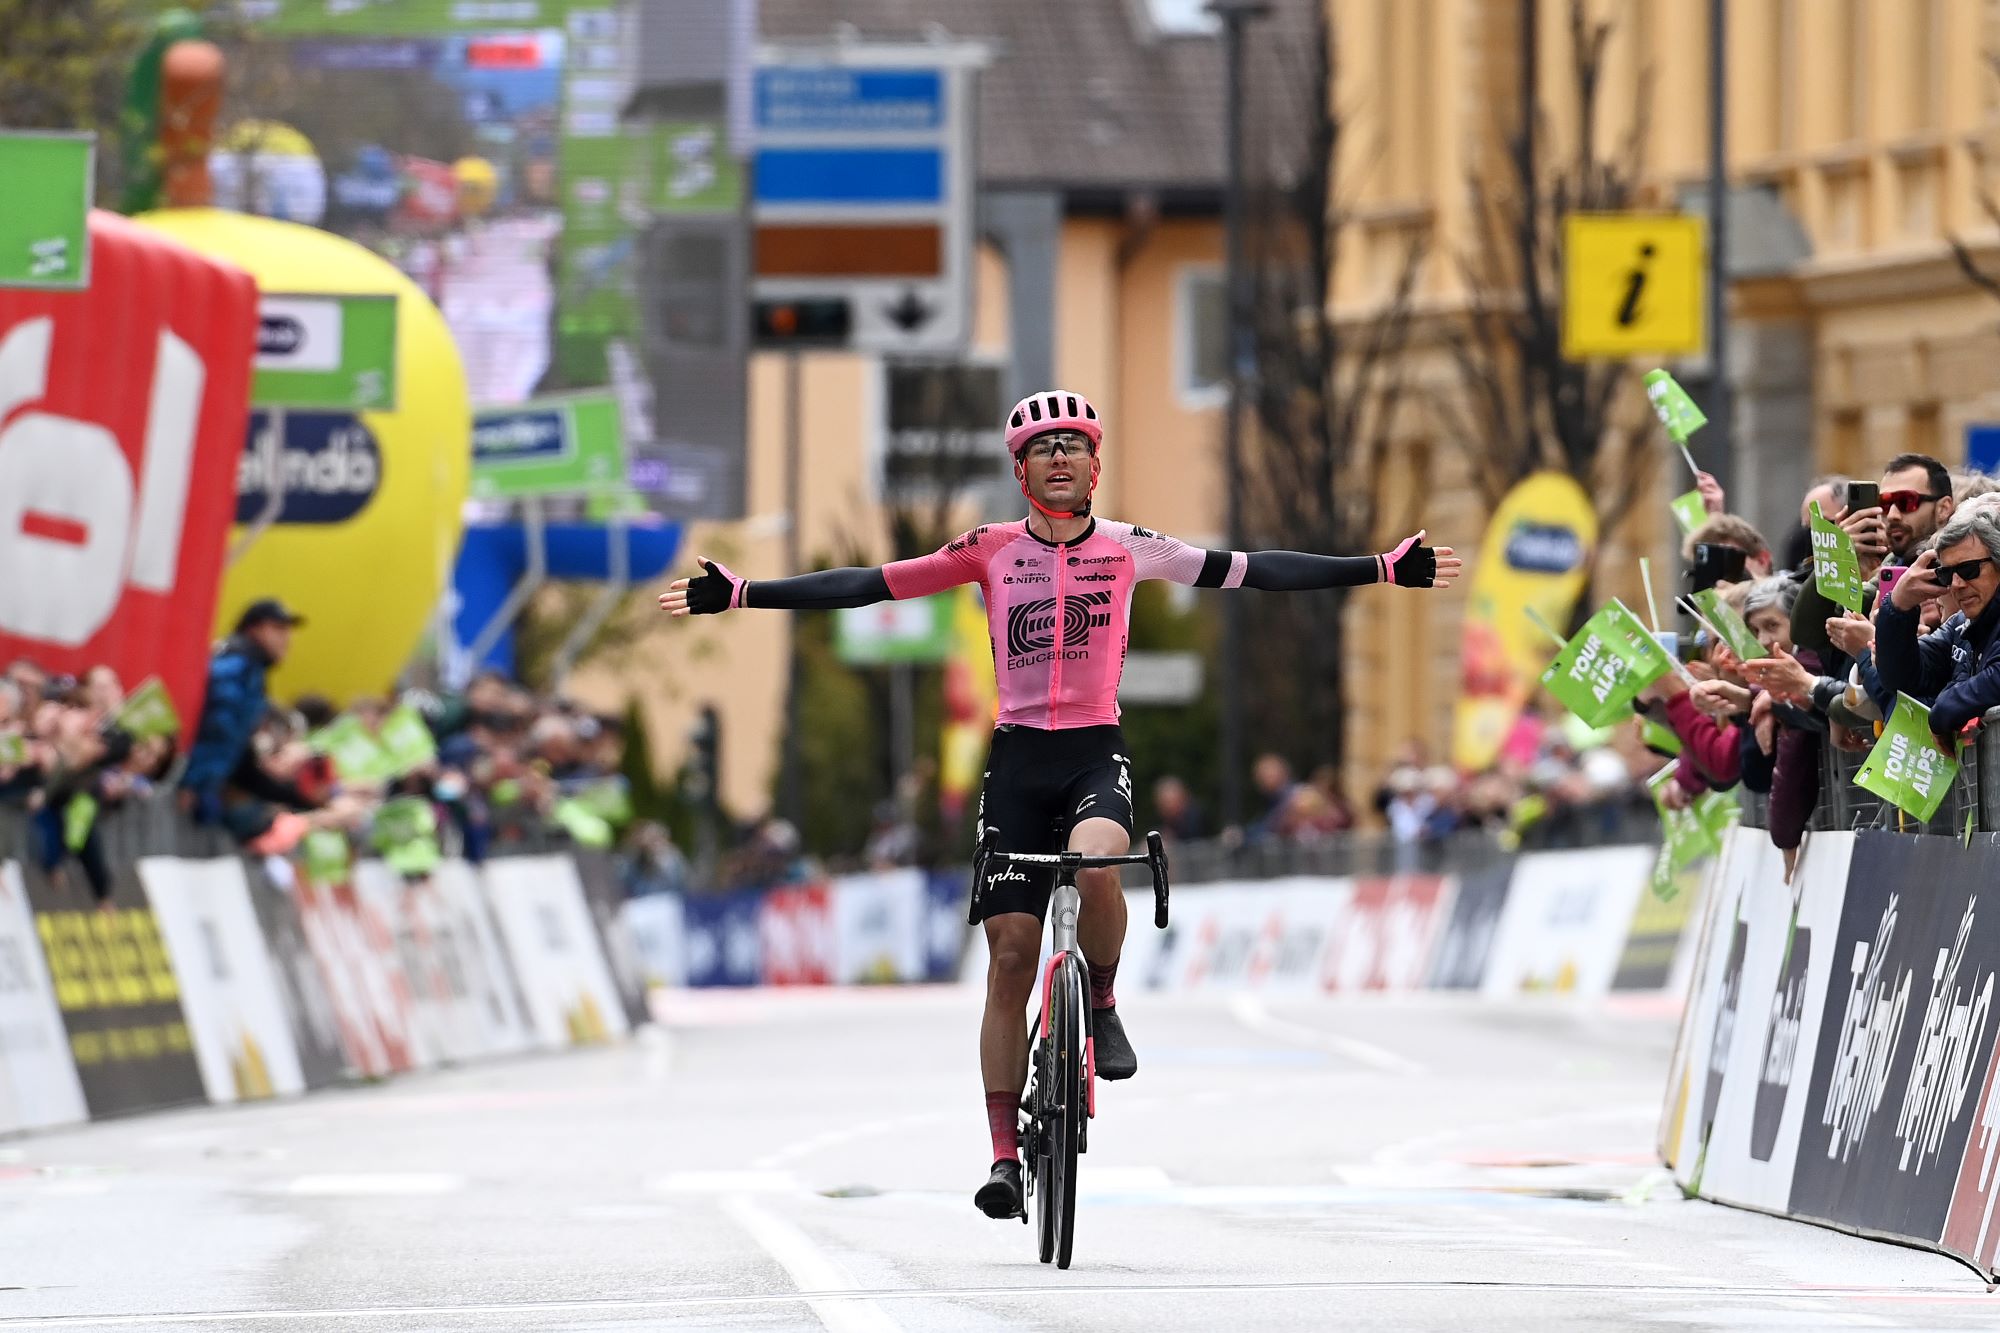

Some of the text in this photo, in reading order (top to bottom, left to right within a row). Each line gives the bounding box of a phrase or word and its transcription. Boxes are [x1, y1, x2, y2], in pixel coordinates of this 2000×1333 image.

[1082, 555, 1126, 565] easypost
[1814, 560, 1839, 579] LPS
[1016, 576, 1051, 584] NIPPO
[1074, 572, 1116, 582] wahoo
[1007, 649, 1089, 671] Education
[1568, 633, 1603, 682] TOUR
[1591, 653, 1624, 704] ALPS
[1884, 733, 1909, 782] TOUR
[1911, 746, 1937, 799] ALPS
